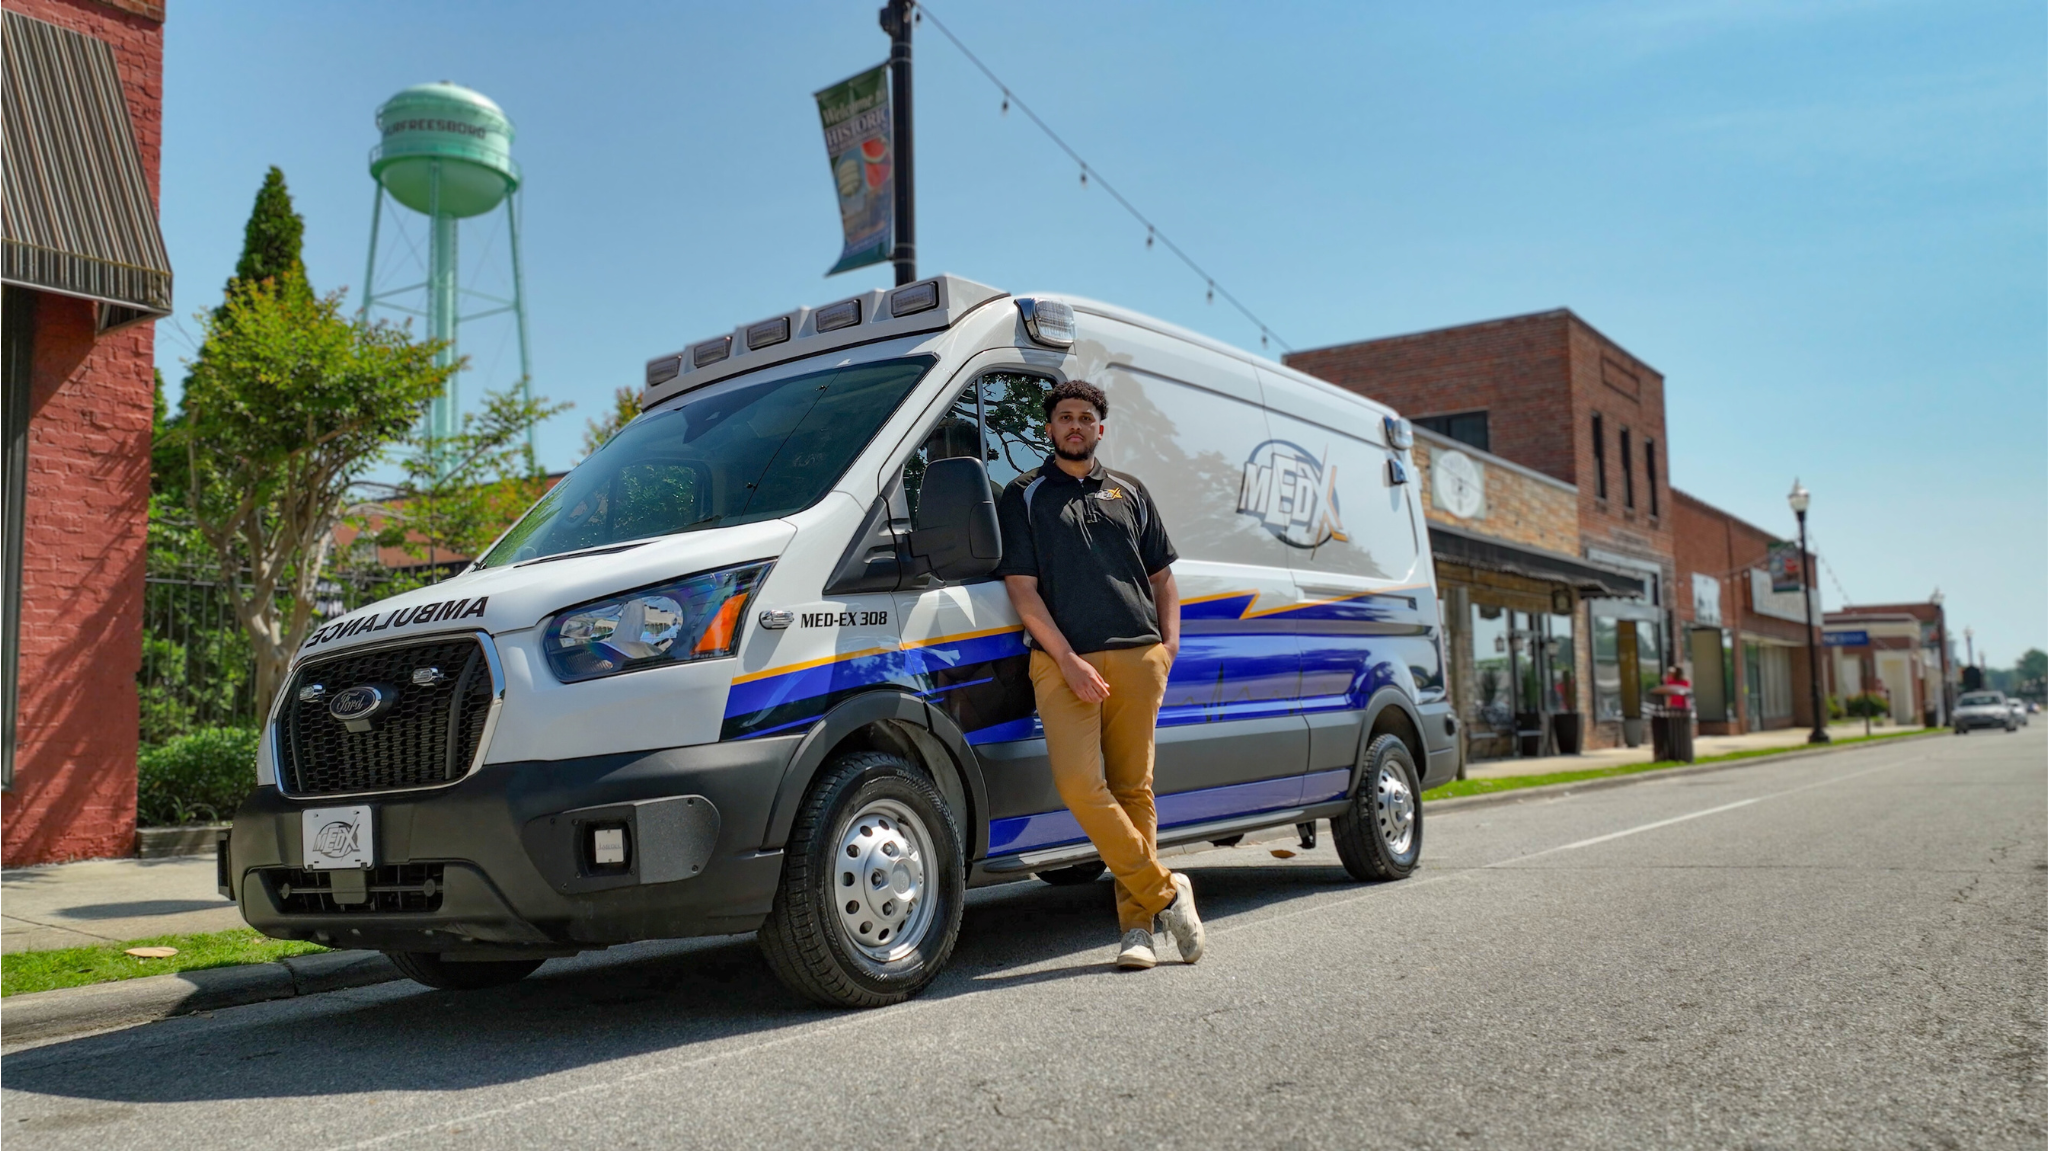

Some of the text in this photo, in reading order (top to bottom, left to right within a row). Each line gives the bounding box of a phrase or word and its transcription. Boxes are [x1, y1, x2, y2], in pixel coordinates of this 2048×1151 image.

[826, 106, 889, 147] HISTORIC
[801, 611, 888, 628] MED-EX 308
[336, 691, 364, 713] Ford
